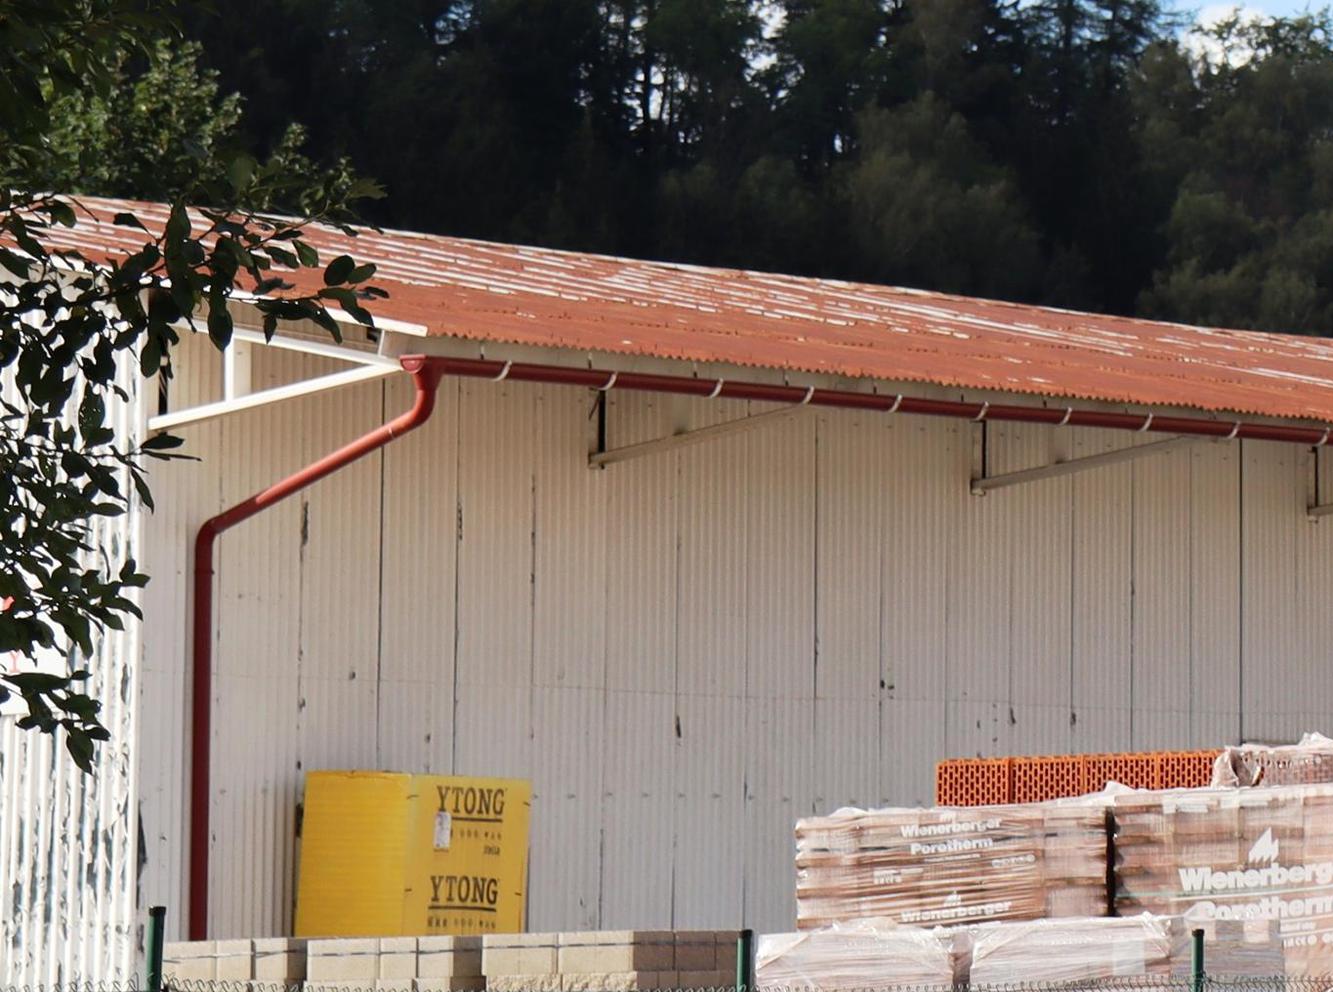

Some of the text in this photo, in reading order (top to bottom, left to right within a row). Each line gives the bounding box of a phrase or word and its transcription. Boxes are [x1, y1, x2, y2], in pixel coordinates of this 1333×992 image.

[436, 786, 505, 815] YTONG
[900, 818, 1003, 838] Wienerberger
[430, 875, 498, 904] YTONG
